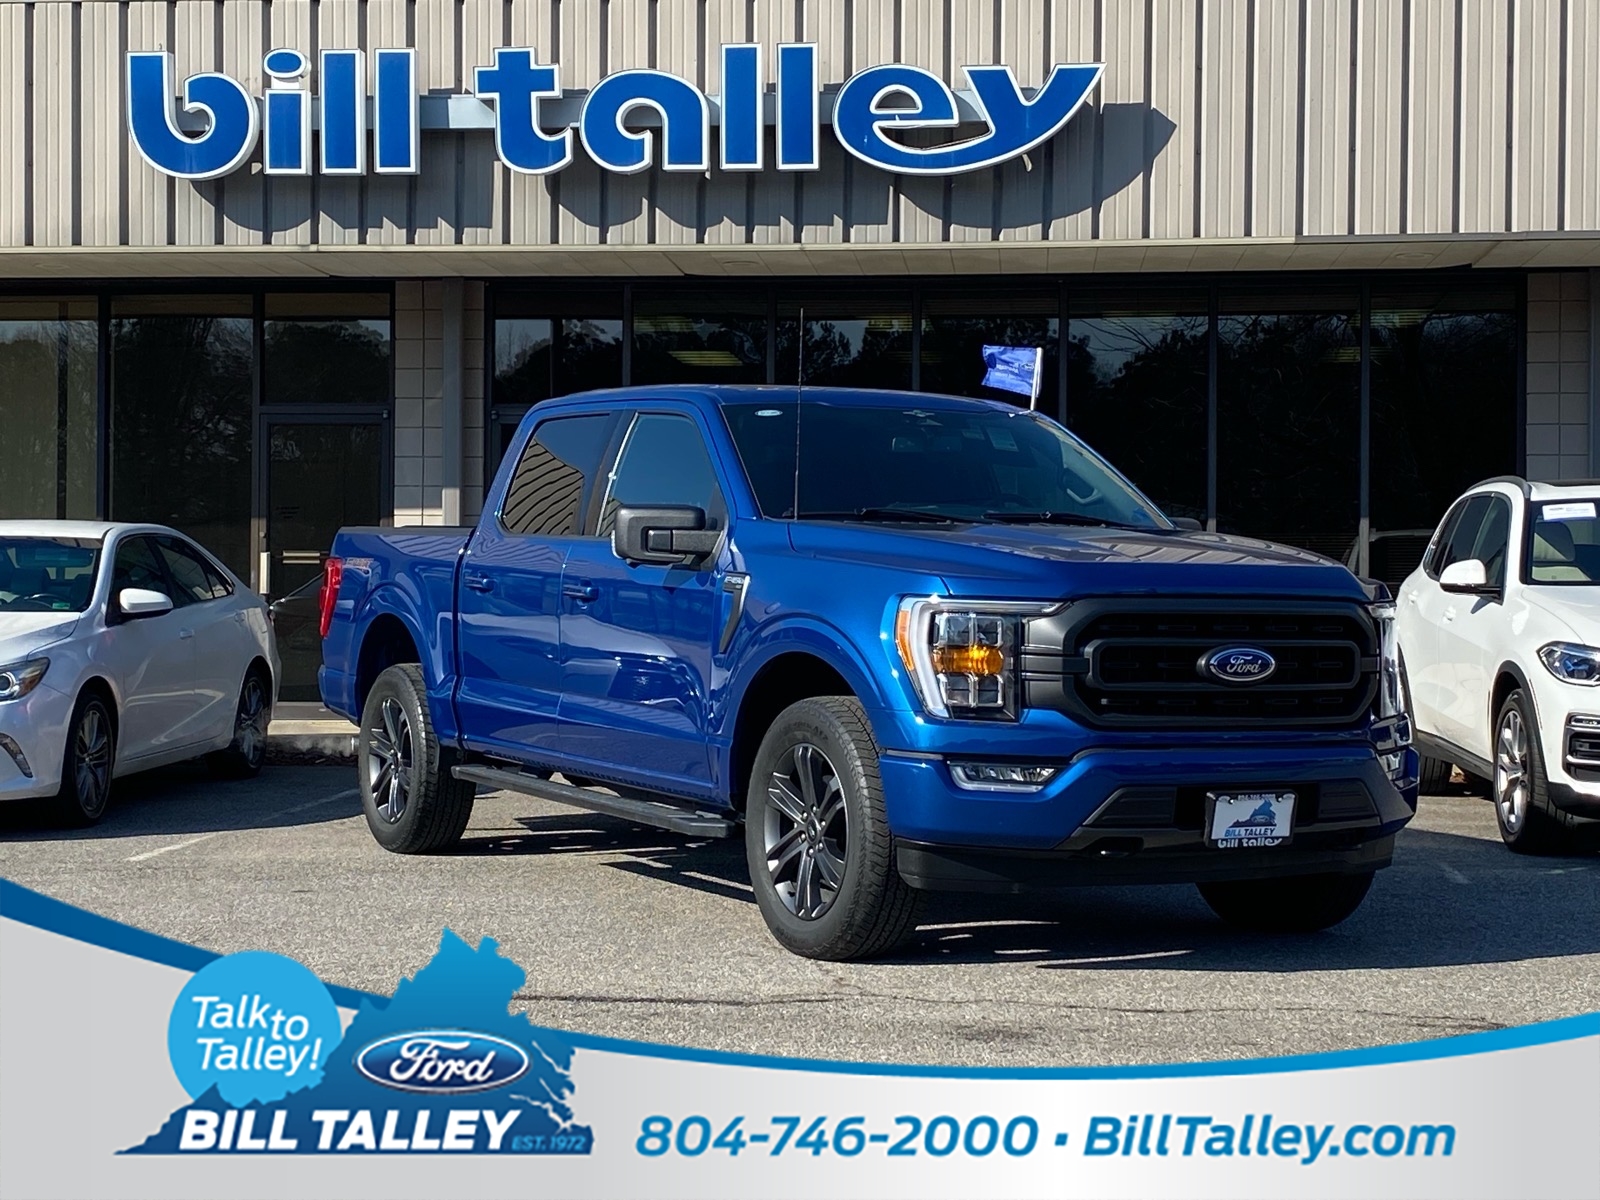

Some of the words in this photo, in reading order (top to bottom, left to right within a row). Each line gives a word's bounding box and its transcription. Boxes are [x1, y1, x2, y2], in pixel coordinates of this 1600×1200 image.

[126, 48, 419, 180] bill
[473, 42, 1106, 177] talley
[1227, 655, 1262, 673] Ford
[1224, 829, 1242, 837] BILL
[1244, 827, 1275, 836] TALLEY
[1217, 838, 1239, 848] bill
[1241, 837, 1283, 847] talley
